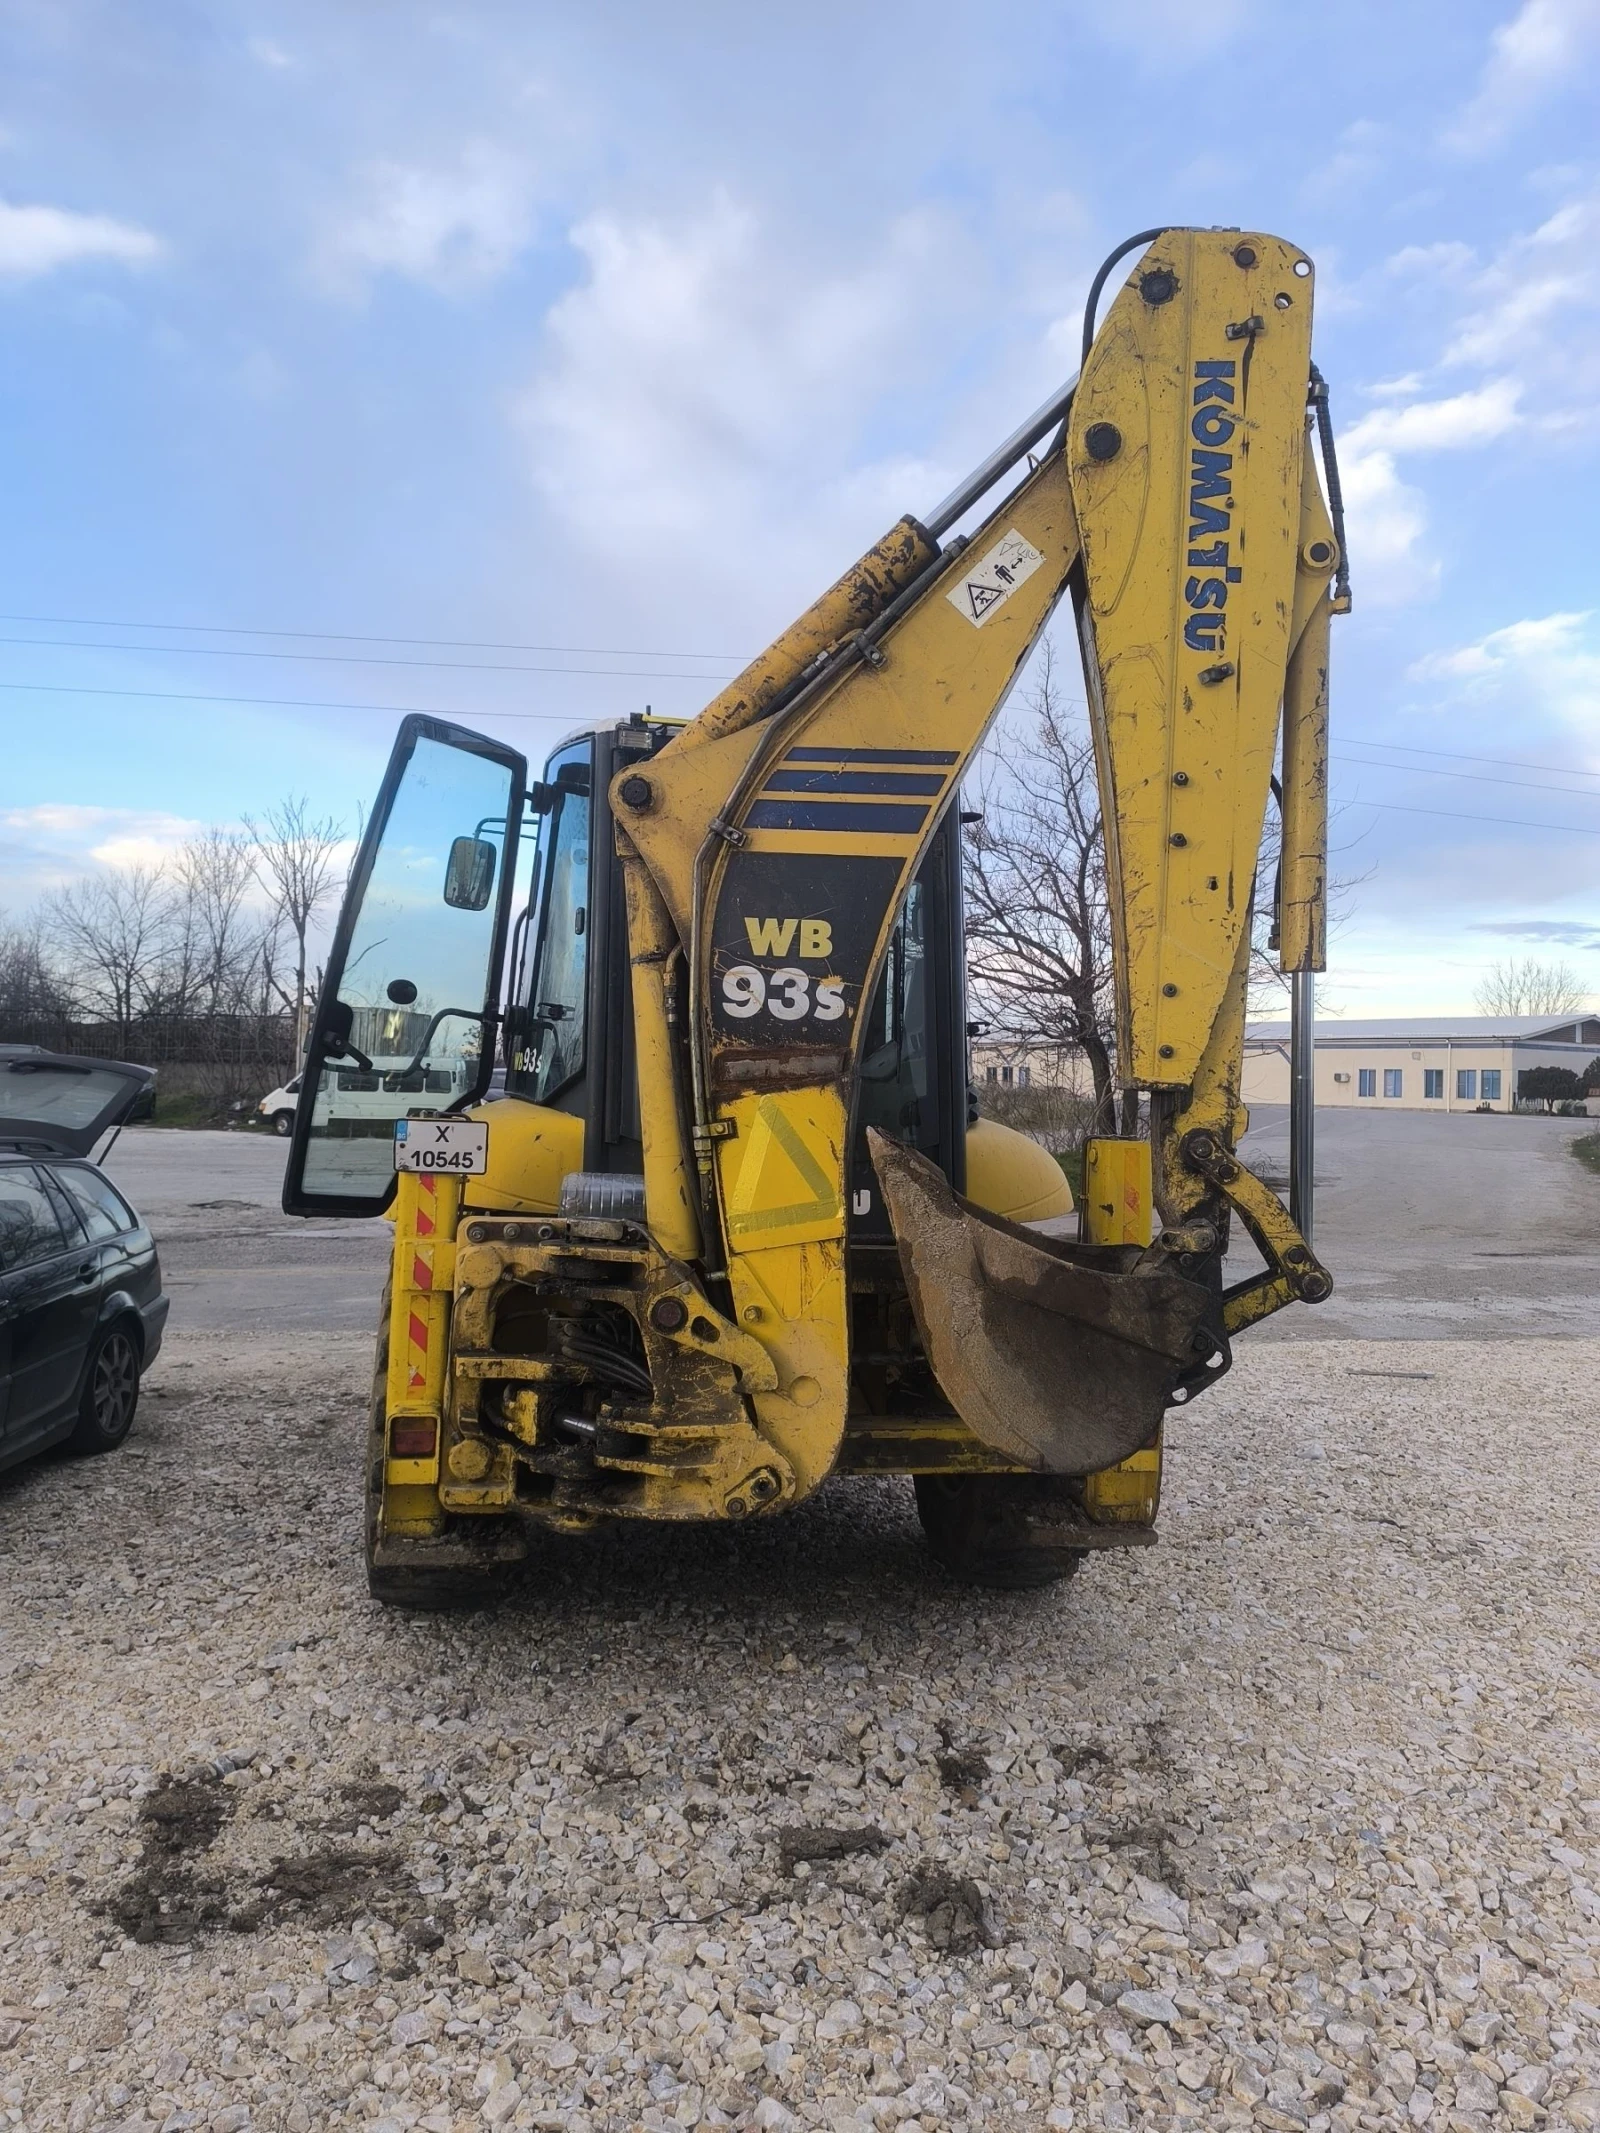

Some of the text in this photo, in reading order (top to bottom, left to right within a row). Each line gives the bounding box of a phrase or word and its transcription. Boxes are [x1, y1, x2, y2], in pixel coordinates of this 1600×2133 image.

[1184, 361, 1242, 651] KOMATSU
[744, 917, 833, 958] WB
[411, 1150, 474, 1169] 10545
